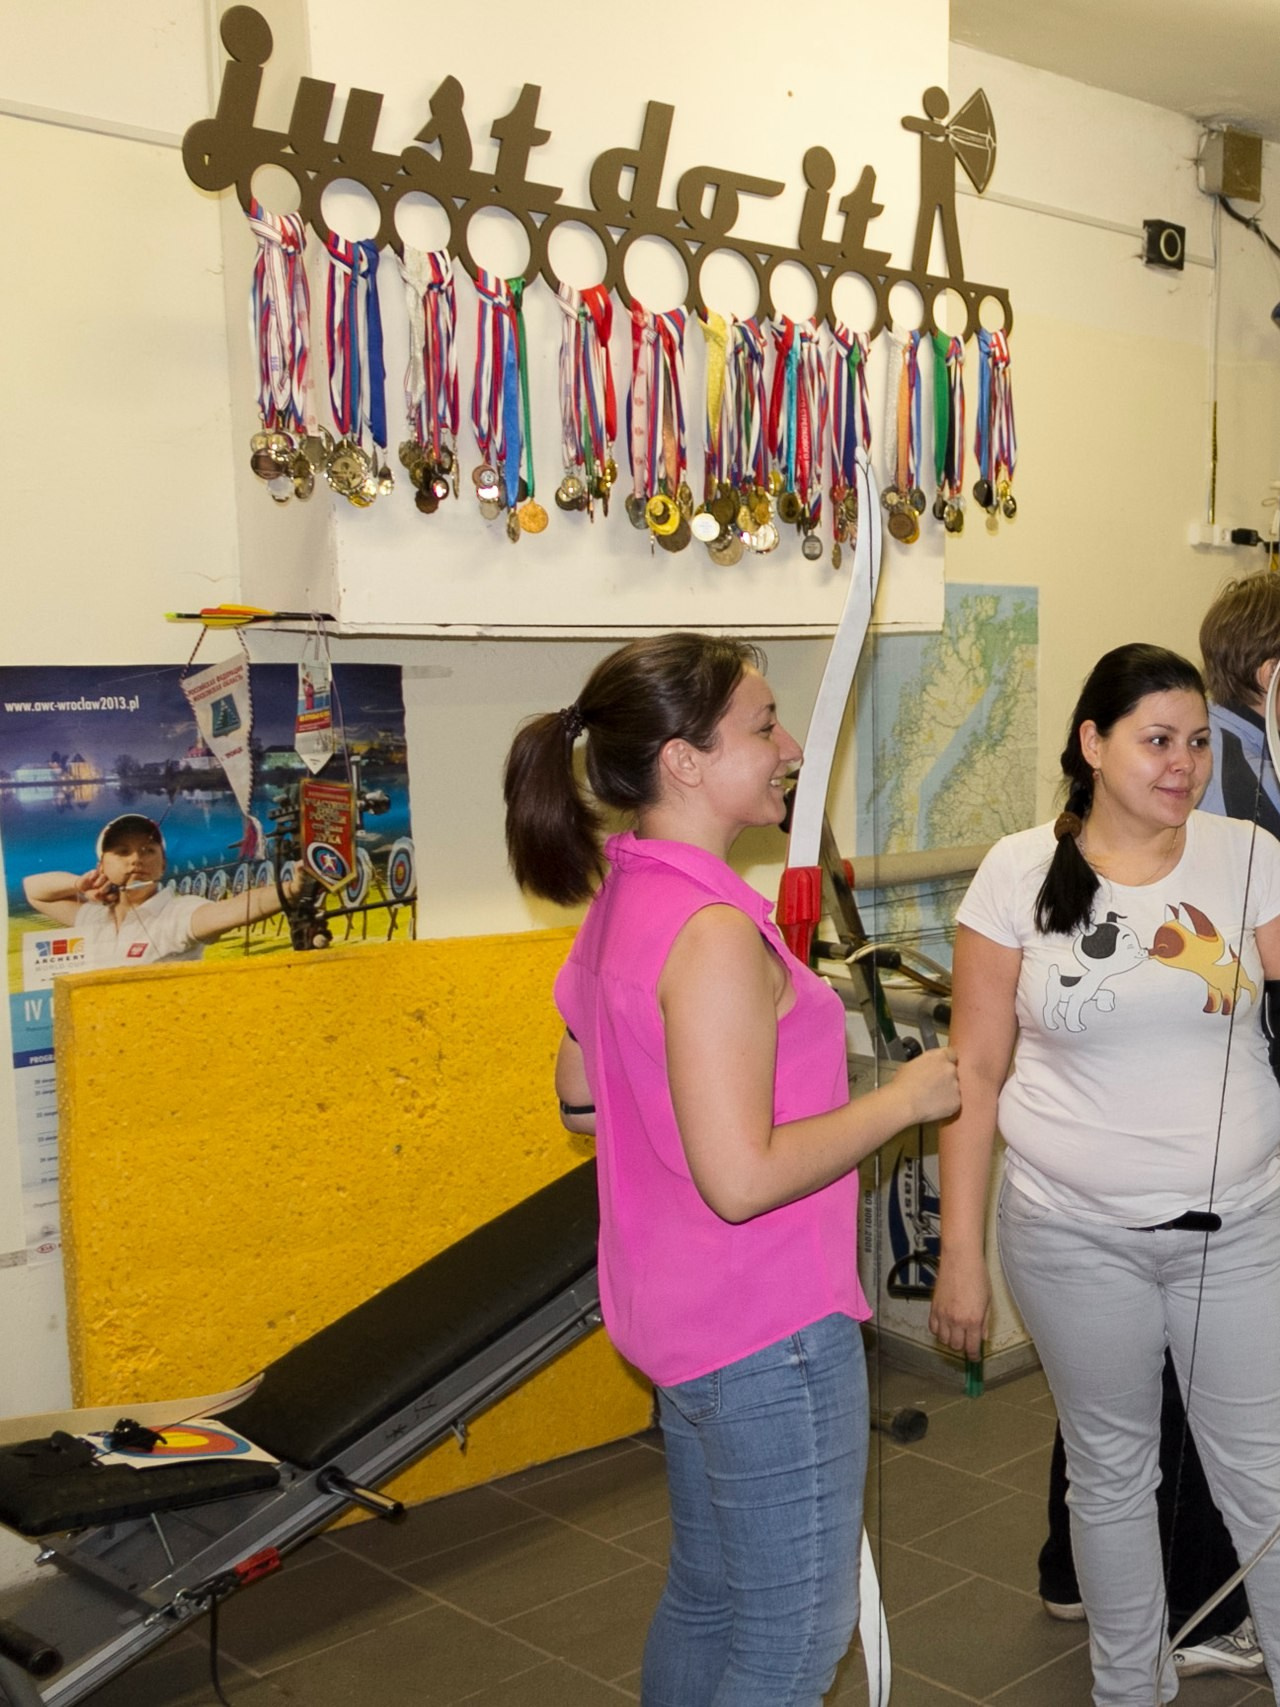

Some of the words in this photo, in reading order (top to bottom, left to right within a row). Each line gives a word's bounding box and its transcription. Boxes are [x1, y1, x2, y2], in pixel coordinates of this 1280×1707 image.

[183, 5, 563, 193] just
[591, 100, 786, 236] do
[800, 145, 891, 265] it
[35, 954, 85, 965] ARCHERY
[25, 998, 43, 1022] IV
